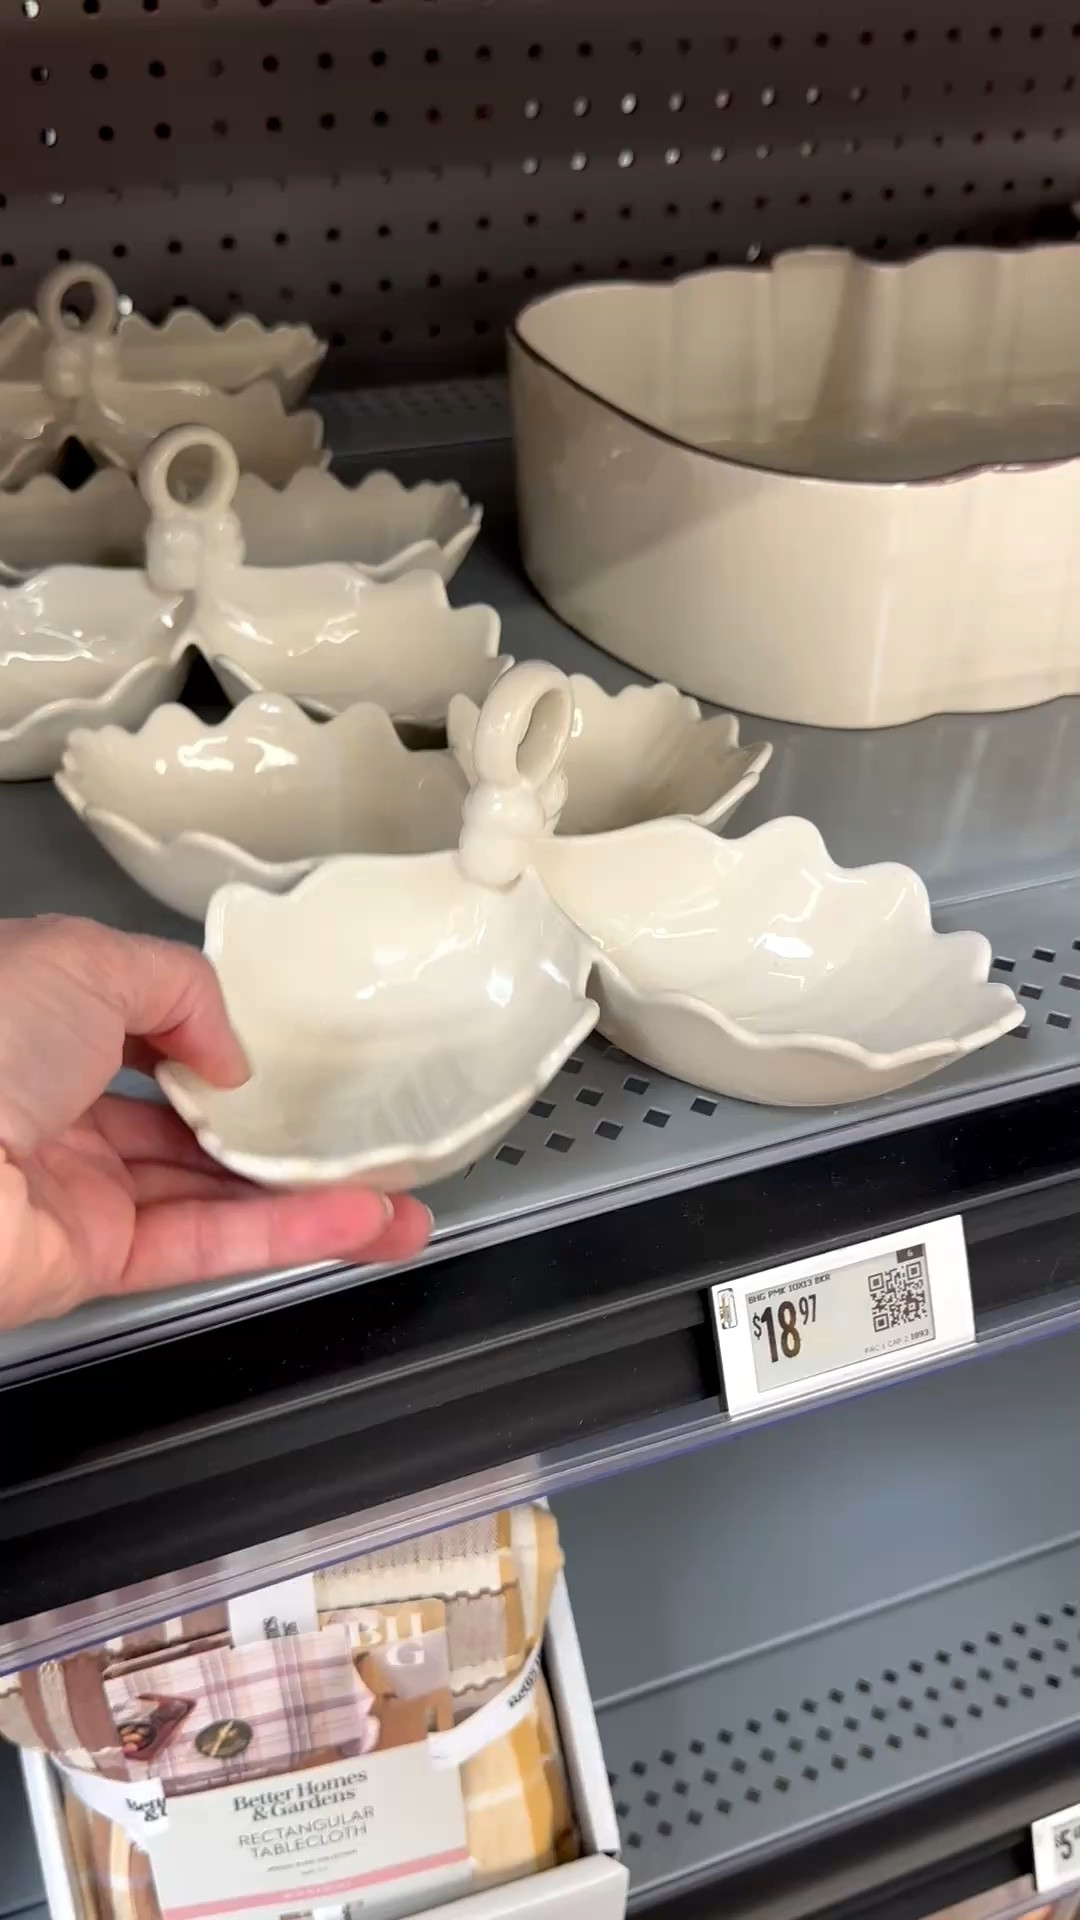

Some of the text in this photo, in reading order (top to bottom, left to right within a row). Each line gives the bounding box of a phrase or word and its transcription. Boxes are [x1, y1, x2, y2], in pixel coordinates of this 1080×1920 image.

[768, 1286, 786, 1298] PMK
[814, 1273, 831, 1285] BKR
[232, 1770, 368, 1812] Better Homes
[238, 1805, 375, 1847] RECTANGULAR
[250, 1823, 368, 1859] TABLECLOTH
